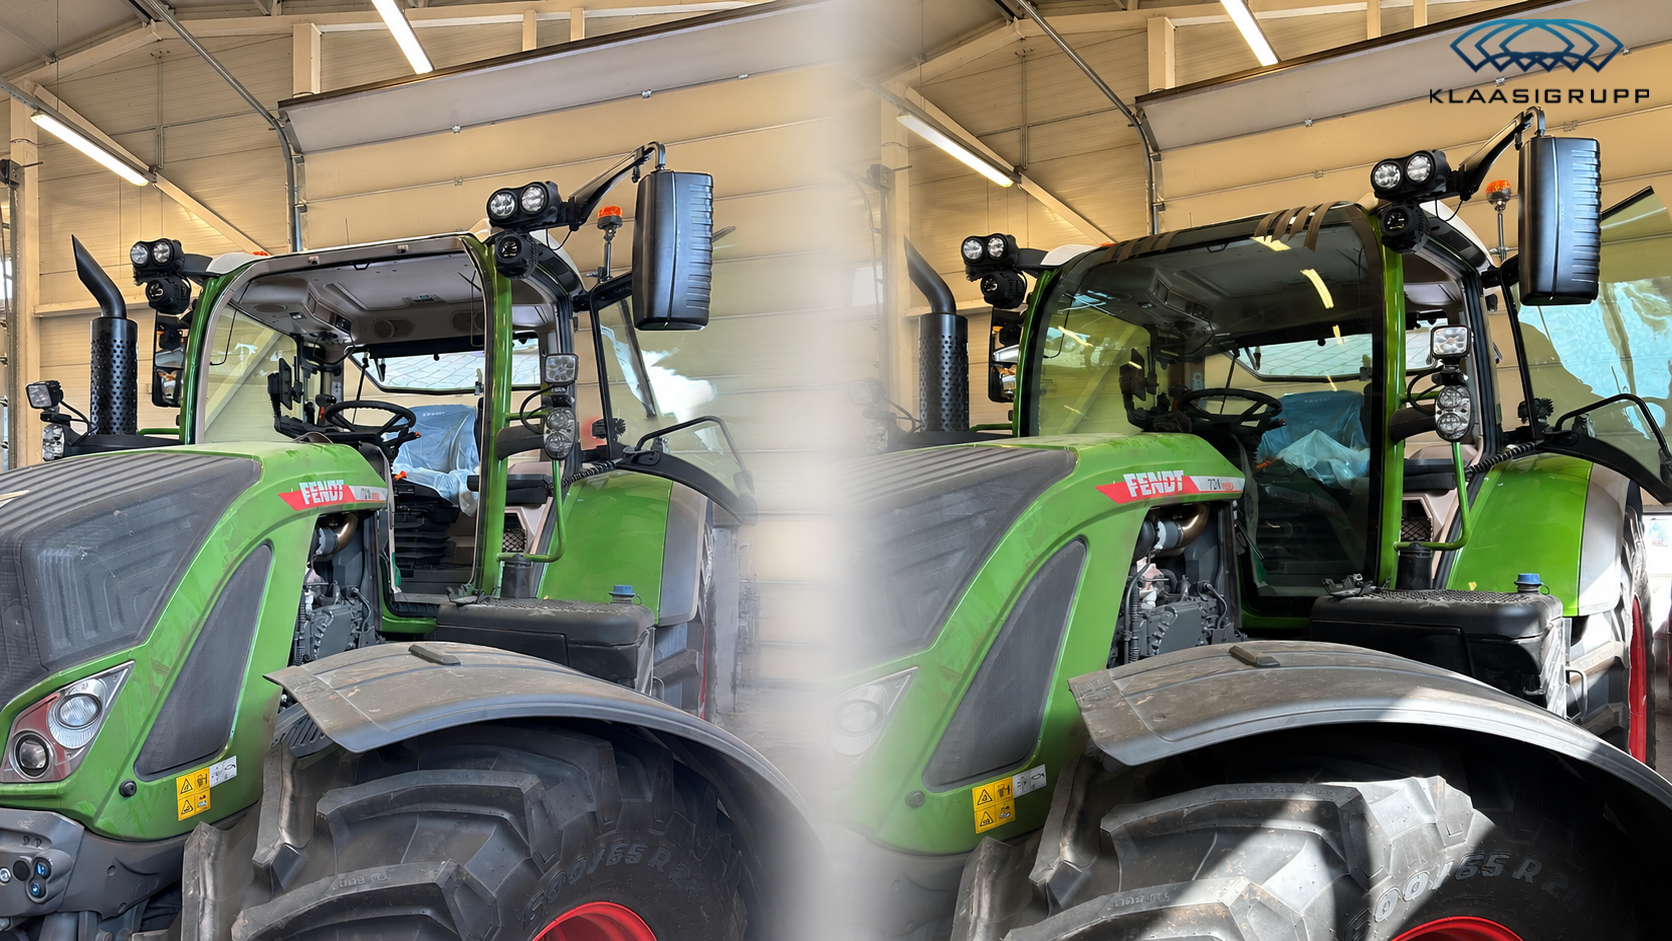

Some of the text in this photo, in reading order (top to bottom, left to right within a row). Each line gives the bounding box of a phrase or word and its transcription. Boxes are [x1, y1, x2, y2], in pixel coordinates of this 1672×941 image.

[299, 480, 345, 505] FENDT
[1123, 470, 1184, 498] FENDT
[648, 849, 673, 873] R
[1512, 857, 1545, 884] R
